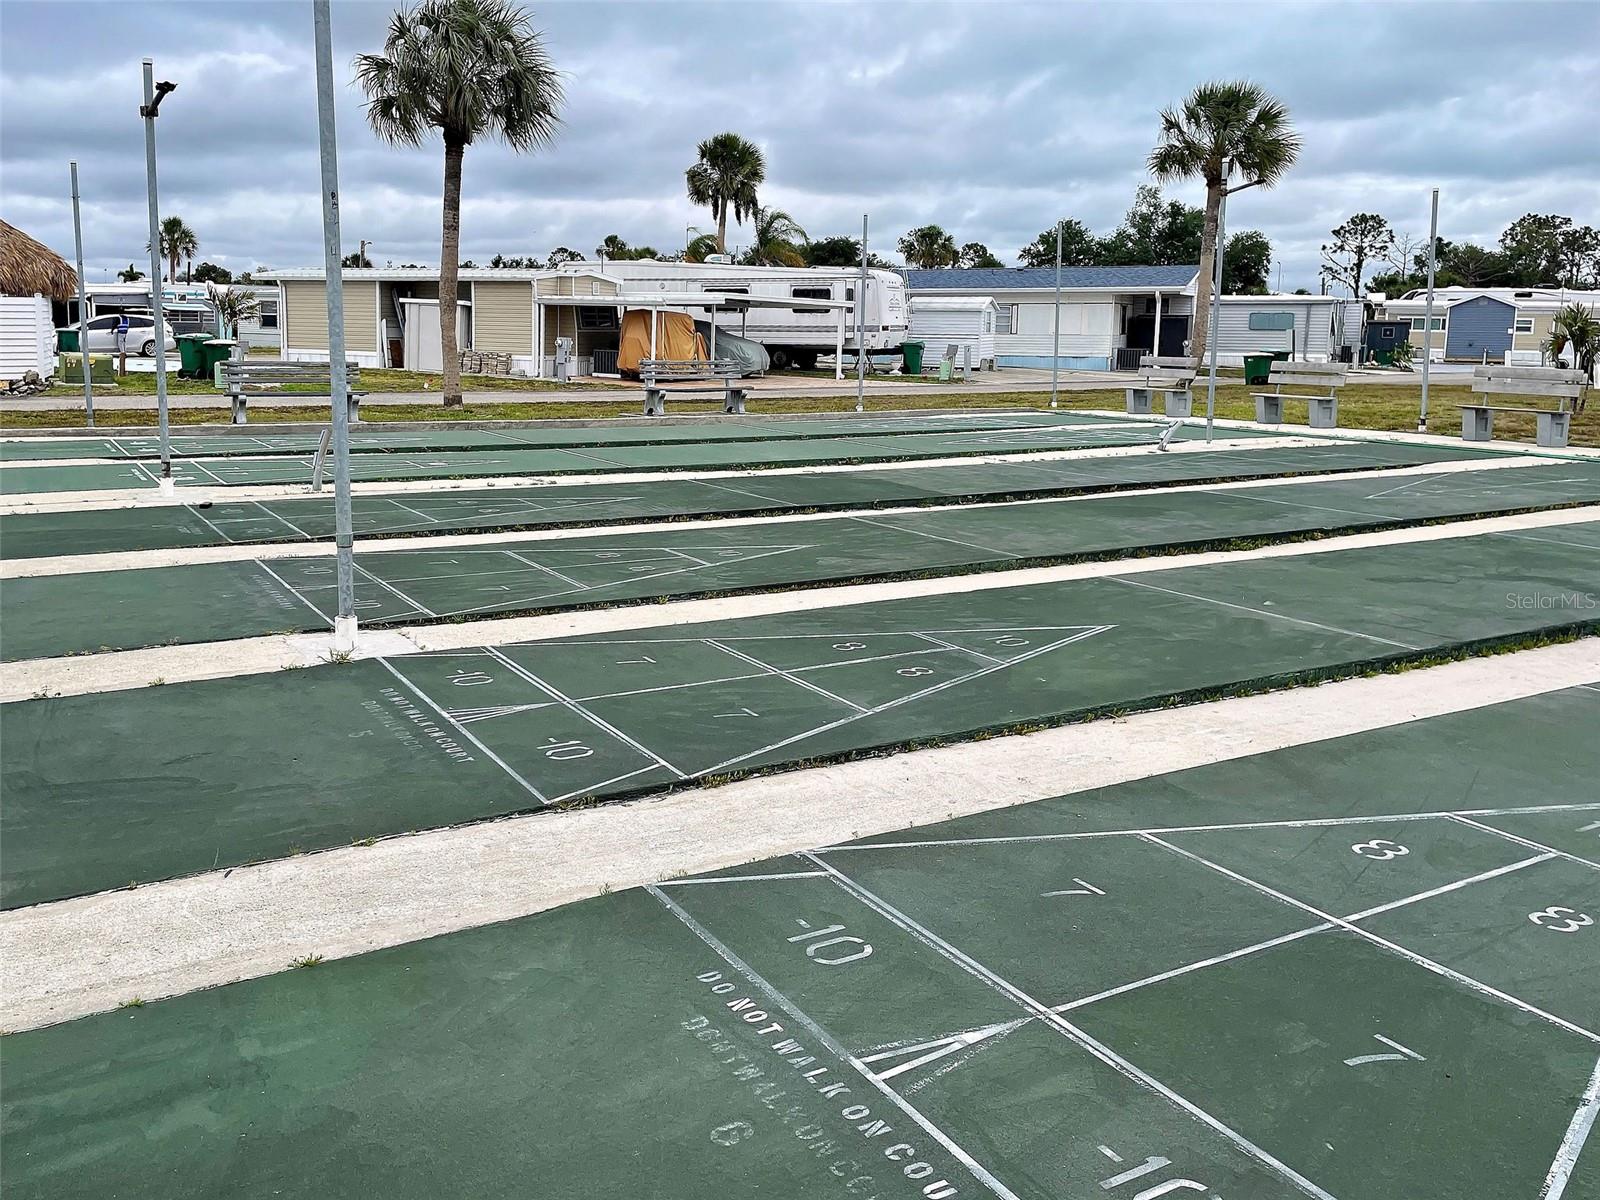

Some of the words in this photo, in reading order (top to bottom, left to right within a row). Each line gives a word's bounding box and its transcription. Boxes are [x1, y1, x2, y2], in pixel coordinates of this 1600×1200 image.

[832, 642, 867, 651] 8
[446, 669, 494, 686] -10
[896, 667, 934, 678] 8
[435, 738, 475, 763] COURT
[536, 737, 594, 760] -10
[786, 918, 873, 965] -10
[696, 970, 736, 995] DO
[727, 997, 784, 1035] NOT
[771, 1038, 852, 1099] WALK
[841, 1104, 893, 1139] ON
